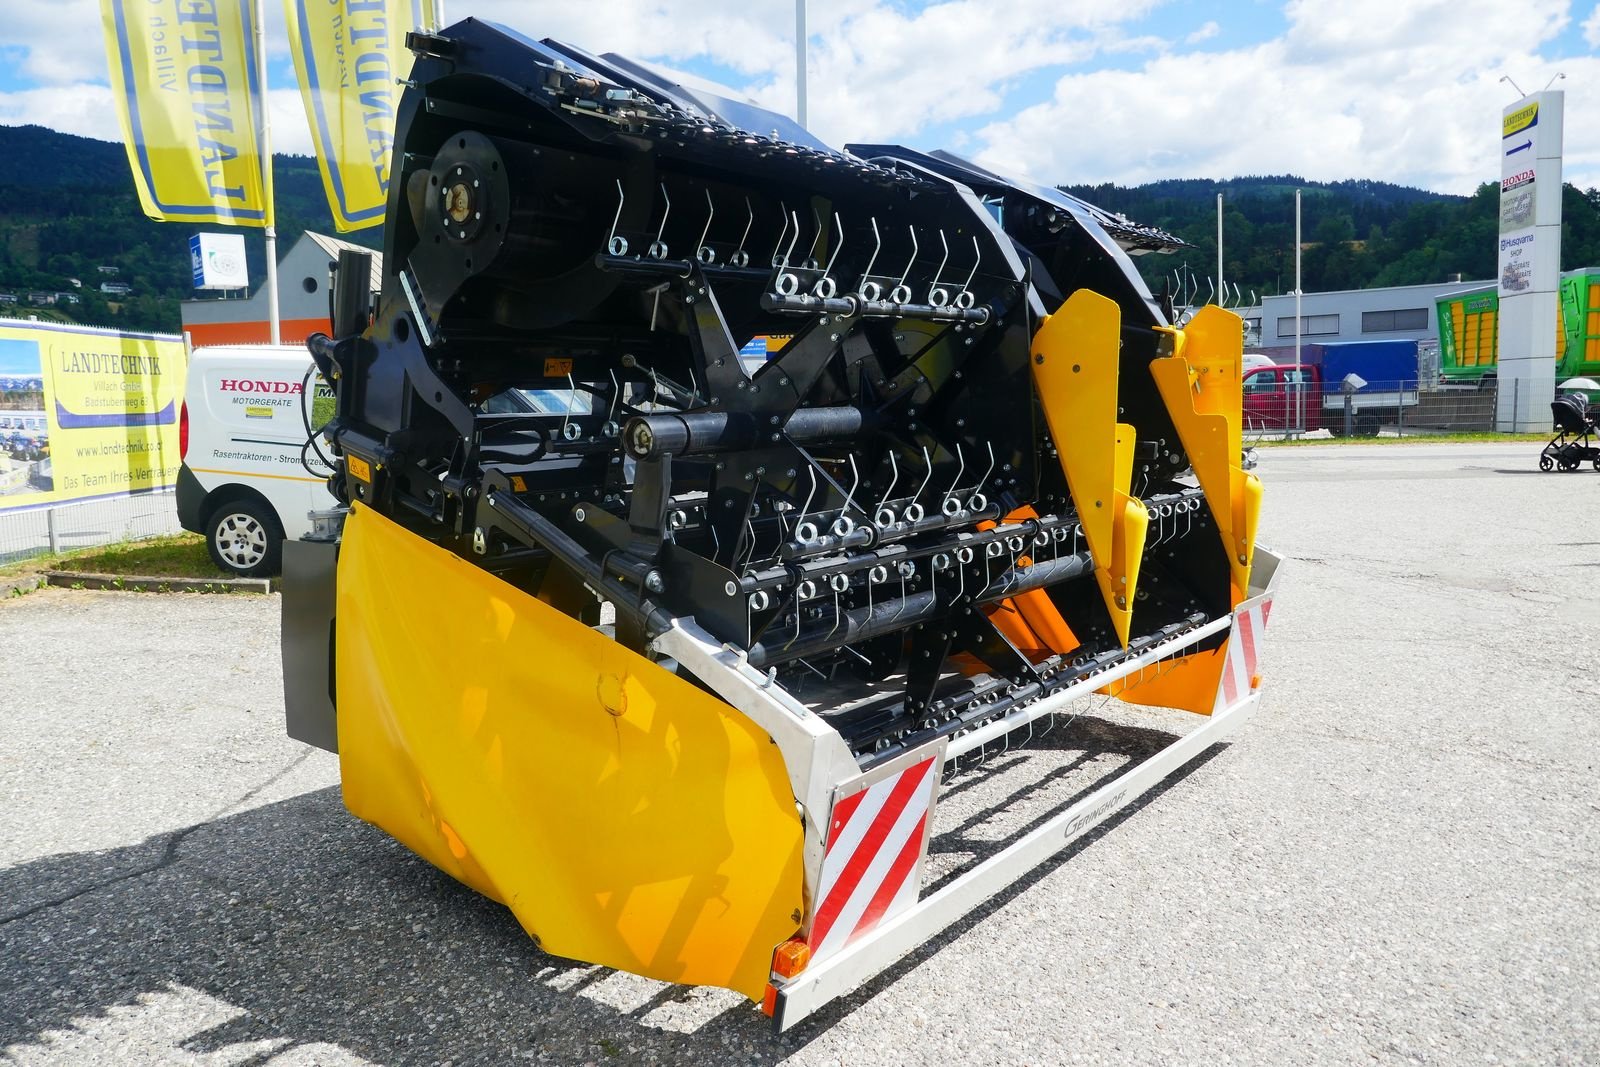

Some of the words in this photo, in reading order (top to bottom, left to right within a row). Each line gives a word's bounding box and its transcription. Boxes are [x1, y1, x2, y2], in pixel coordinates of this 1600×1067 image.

[1502, 170, 1535, 188] HONDA
[61, 351, 162, 375] LANDTECHNIK
[220, 379, 305, 394] HONDA
[212, 449, 273, 462] Rasentraktoren
[63, 476, 78, 489] Das
[82, 472, 108, 487] Team
[110, 470, 133, 484] Ihres
[1064, 789, 1127, 838] GERINGHOFF
